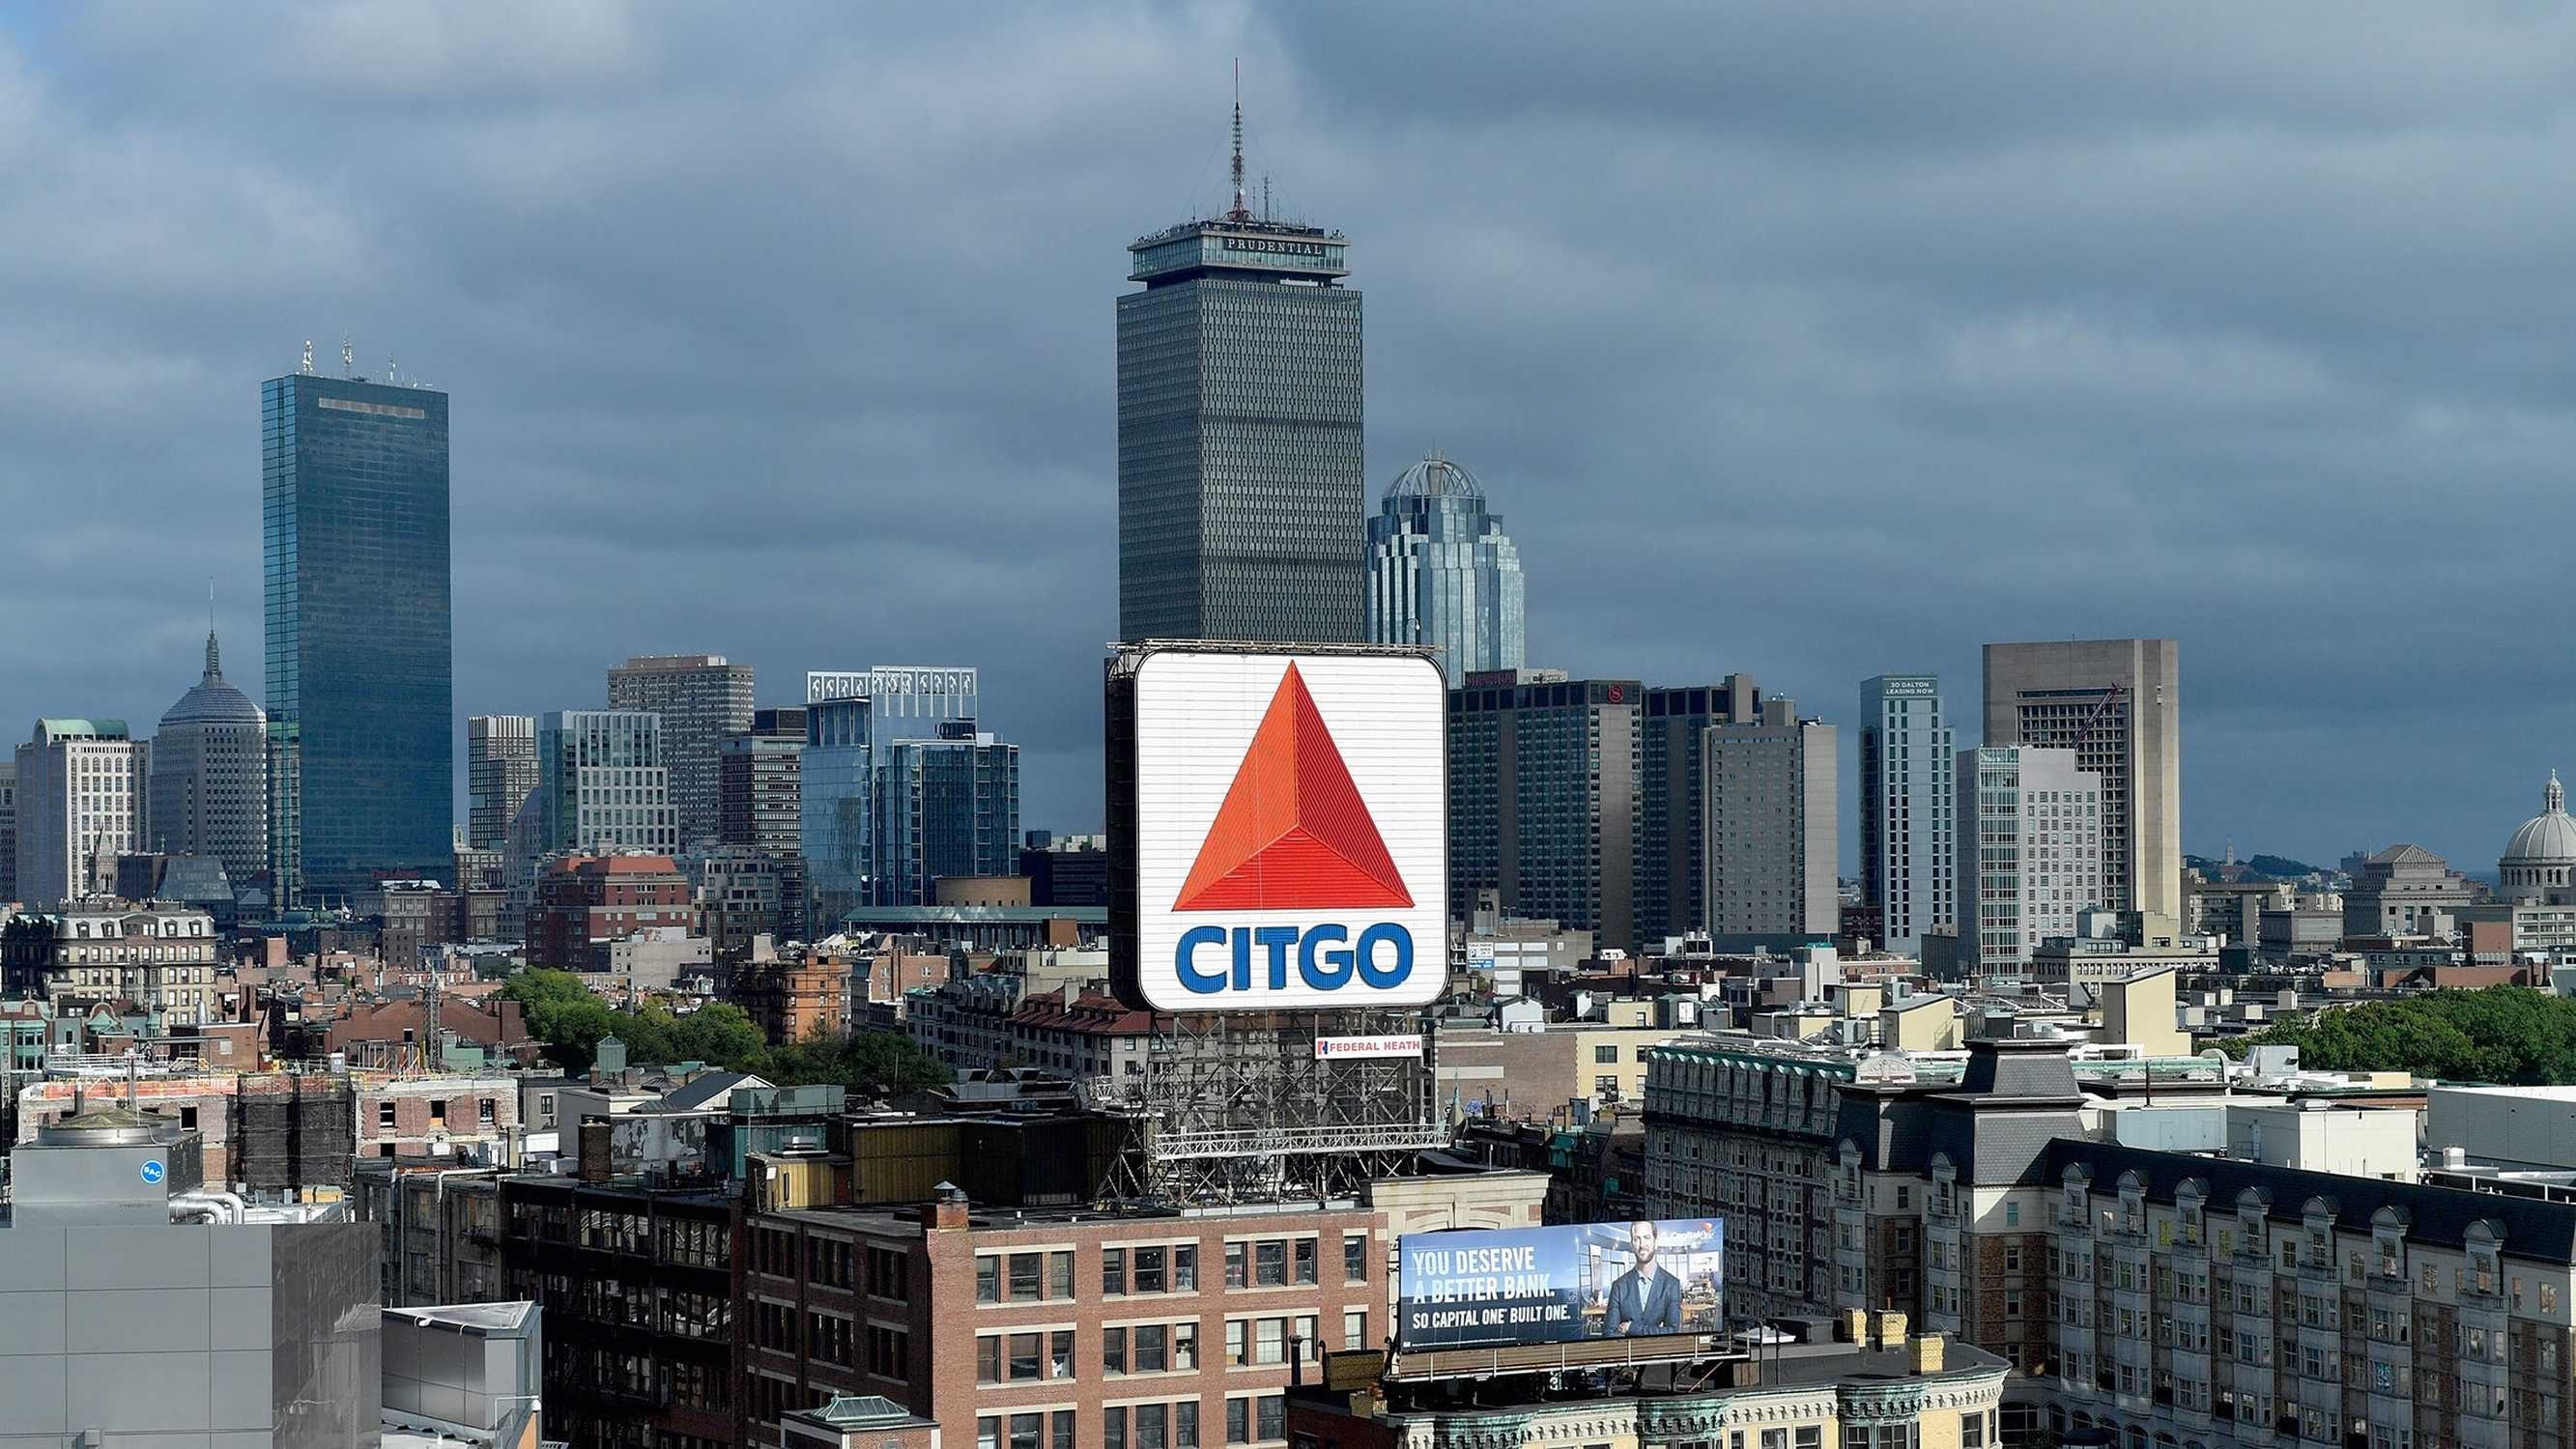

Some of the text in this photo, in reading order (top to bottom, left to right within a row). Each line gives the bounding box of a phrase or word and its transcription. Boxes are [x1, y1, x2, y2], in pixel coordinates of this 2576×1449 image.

[1227, 238, 1322, 255] PRUDENTIAL
[1175, 923, 1415, 994] CITGO
[1330, 1040, 1420, 1052] FEDERAL HEATH
[1412, 1246, 1535, 1275] YOU DESERVE
[1413, 1273, 1556, 1304] A BETTER BANK.
[1413, 1312, 1429, 1329] SO
[1432, 1309, 1479, 1328] CAPITAL
[1509, 1306, 1543, 1323] BUILT
[1545, 1304, 1571, 1321] ONE.
